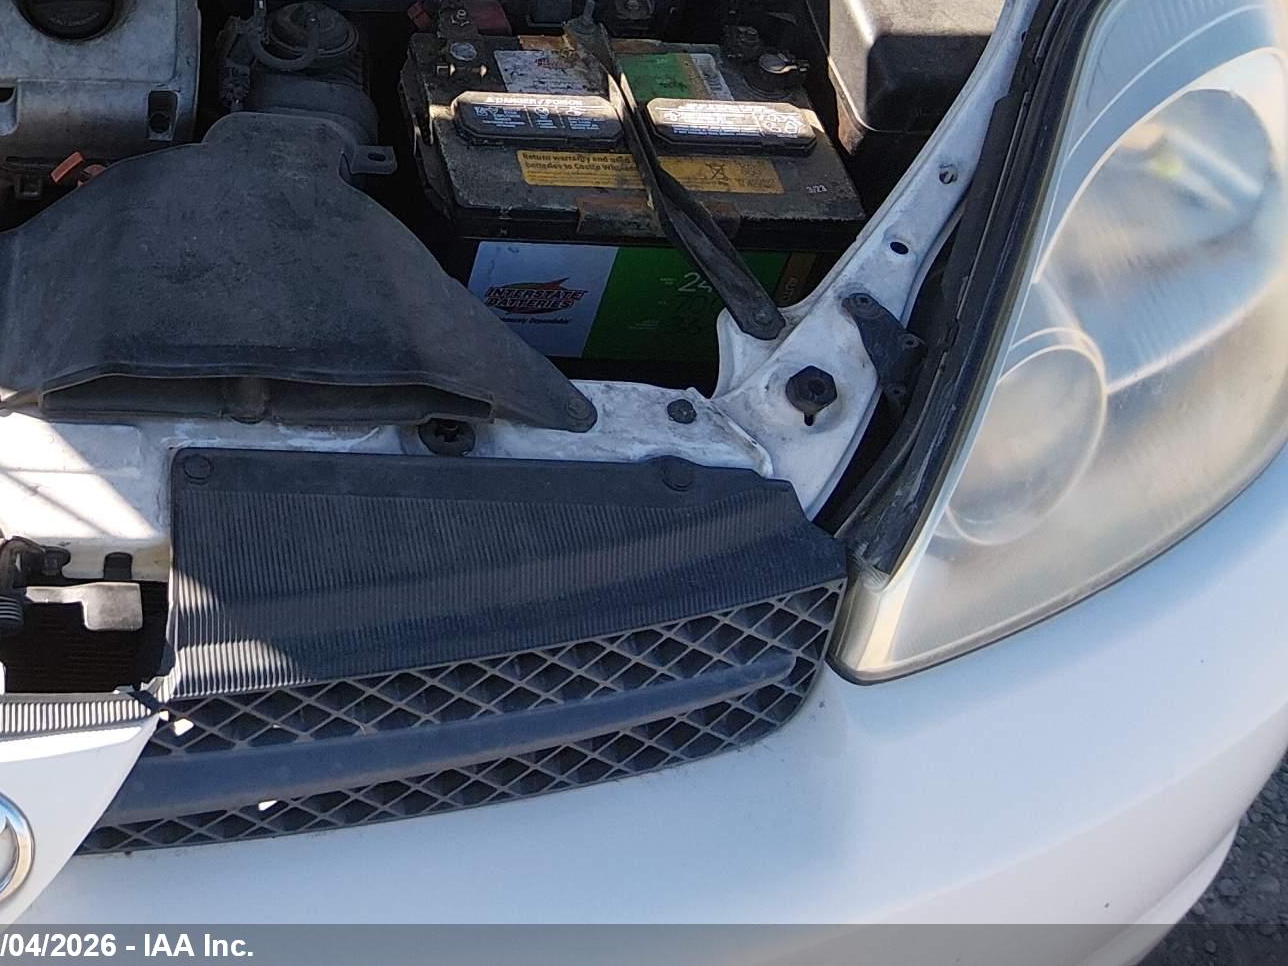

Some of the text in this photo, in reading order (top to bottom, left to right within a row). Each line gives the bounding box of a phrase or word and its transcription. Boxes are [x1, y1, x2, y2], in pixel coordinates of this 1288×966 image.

[522, 152, 552, 161] Return
[592, 155, 608, 163] and
[486, 287, 585, 300] INTERSTATE
[487, 296, 575, 309] BATTERIES
